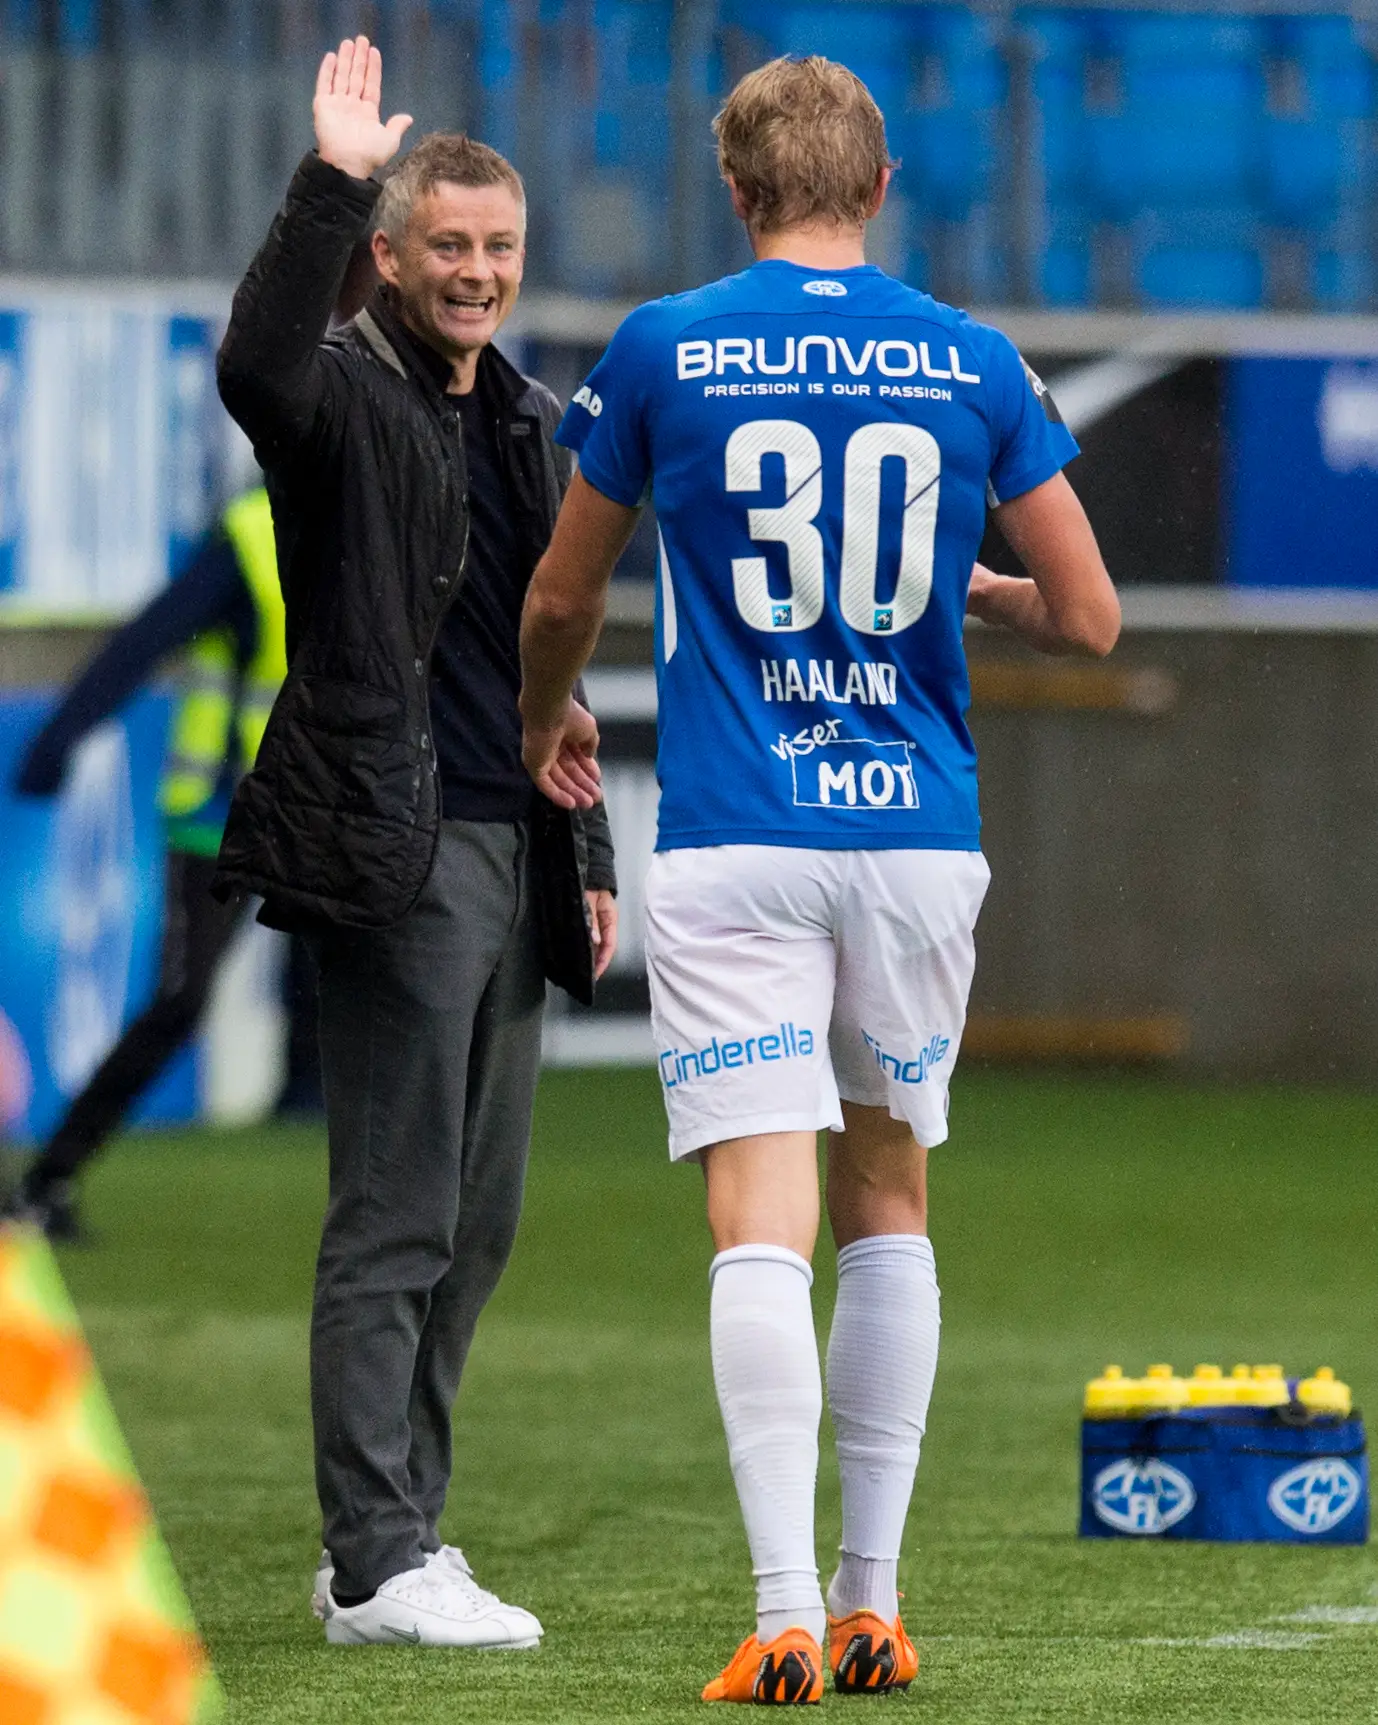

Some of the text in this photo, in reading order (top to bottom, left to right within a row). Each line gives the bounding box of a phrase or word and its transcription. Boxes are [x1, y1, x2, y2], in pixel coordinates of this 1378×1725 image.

[677, 335, 981, 384] BRUNVOLL
[704, 382, 952, 402] PRECISION IS OUR PASSION
[725, 419, 942, 636] 30
[760, 658, 898, 705] HAALAND
[770, 718, 843, 761] viser
[818, 760, 915, 807] MOT
[660, 1022, 814, 1088] Cinderella
